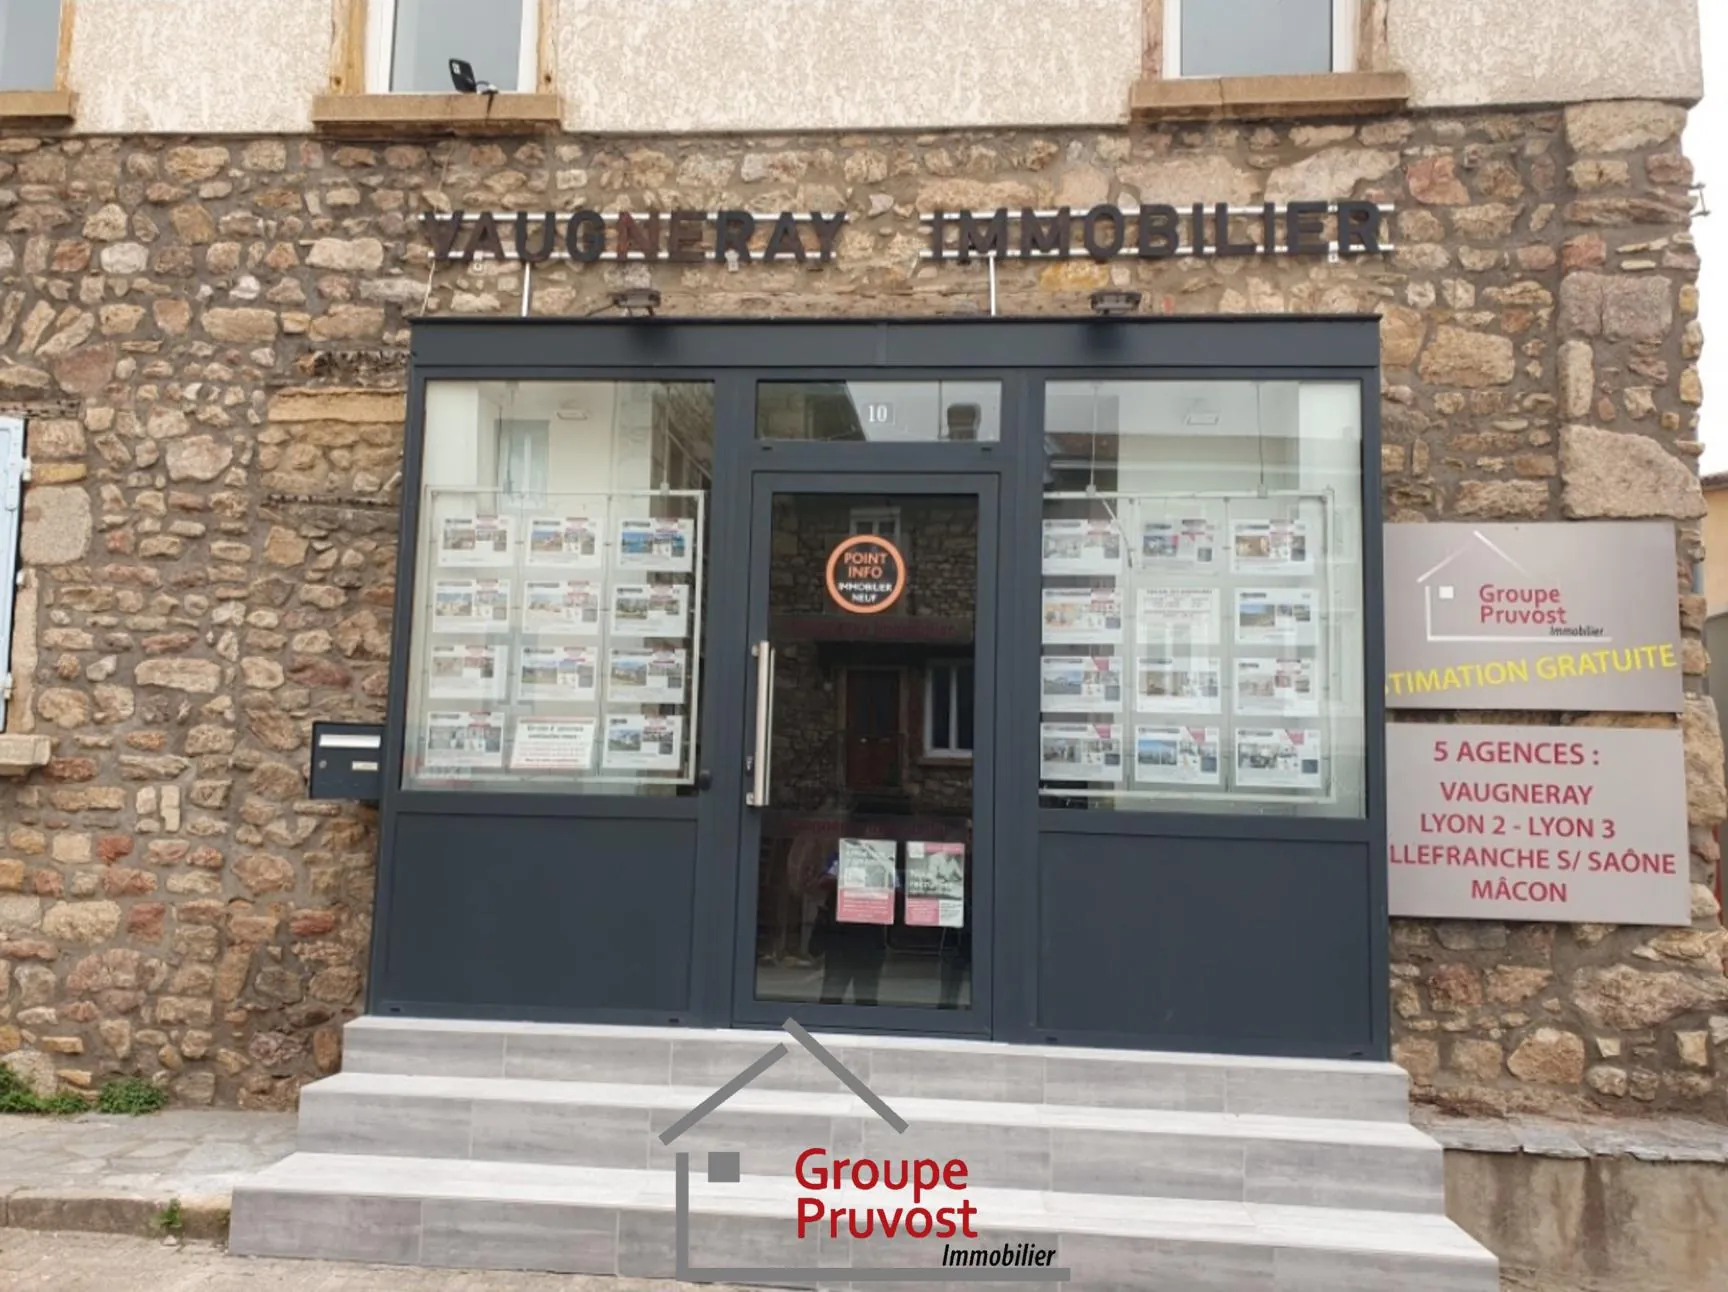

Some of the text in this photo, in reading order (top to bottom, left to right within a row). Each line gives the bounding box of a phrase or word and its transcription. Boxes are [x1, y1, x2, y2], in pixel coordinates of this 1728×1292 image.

[424, 201, 1382, 264] VAUGNERAY IMMOBILIER
[869, 404, 888, 422] 10
[843, 552, 889, 564] POINT
[848, 566, 883, 579] INFO
[1479, 584, 1561, 609] Groupe
[1480, 605, 1567, 625] Pruvost
[1550, 625, 1604, 638] Immobilier
[1385, 643, 1678, 697] TIMATION GRATUITE
[1433, 741, 1448, 762] 5
[1456, 741, 1585, 766] AGENCES
[1440, 782, 1593, 805] VAUGNERAY
[1420, 813, 1485, 835] LYON
[1492, 816, 1506, 835] 2
[1528, 817, 1594, 838] LYON
[1602, 819, 1616, 839] 3
[1557, 850, 1580, 872] S/
[1588, 848, 1676, 875] SAÔNE
[1471, 876, 1568, 903] MÂCON
